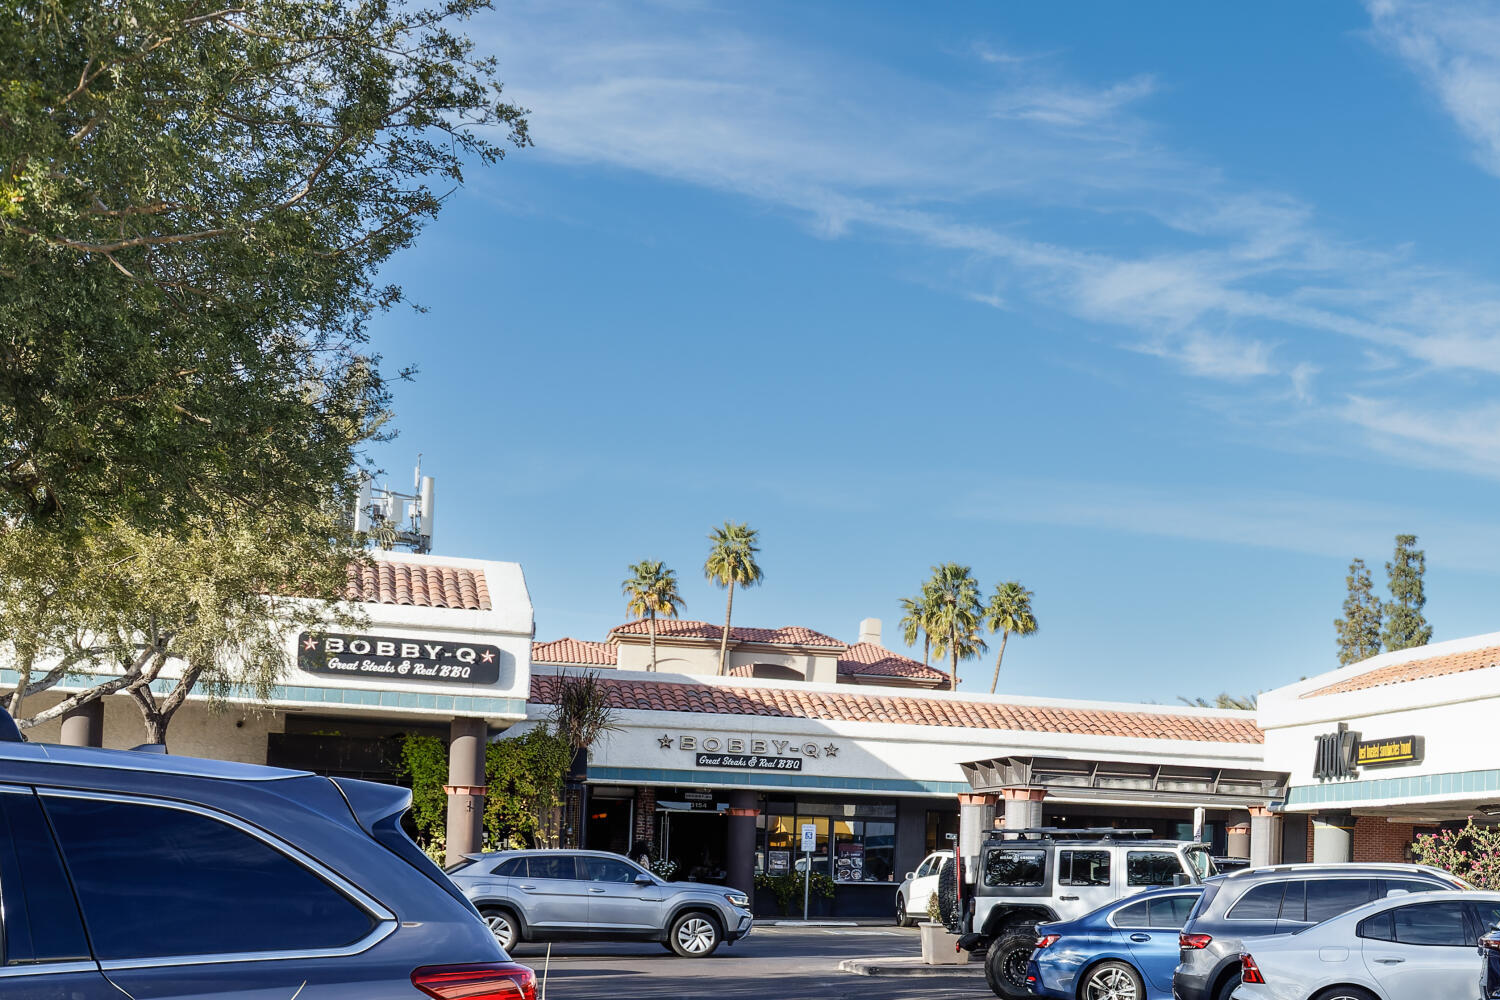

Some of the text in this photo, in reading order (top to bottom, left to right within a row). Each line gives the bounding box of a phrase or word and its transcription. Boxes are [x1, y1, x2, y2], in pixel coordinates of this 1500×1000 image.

[324, 637, 476, 664] BOBBY-Q
[328, 658, 471, 679] Great Steaks & Real BBQ
[679, 735, 821, 759] BOBBY-Q
[699, 755, 800, 769] Great Steaks & Real BBQ
